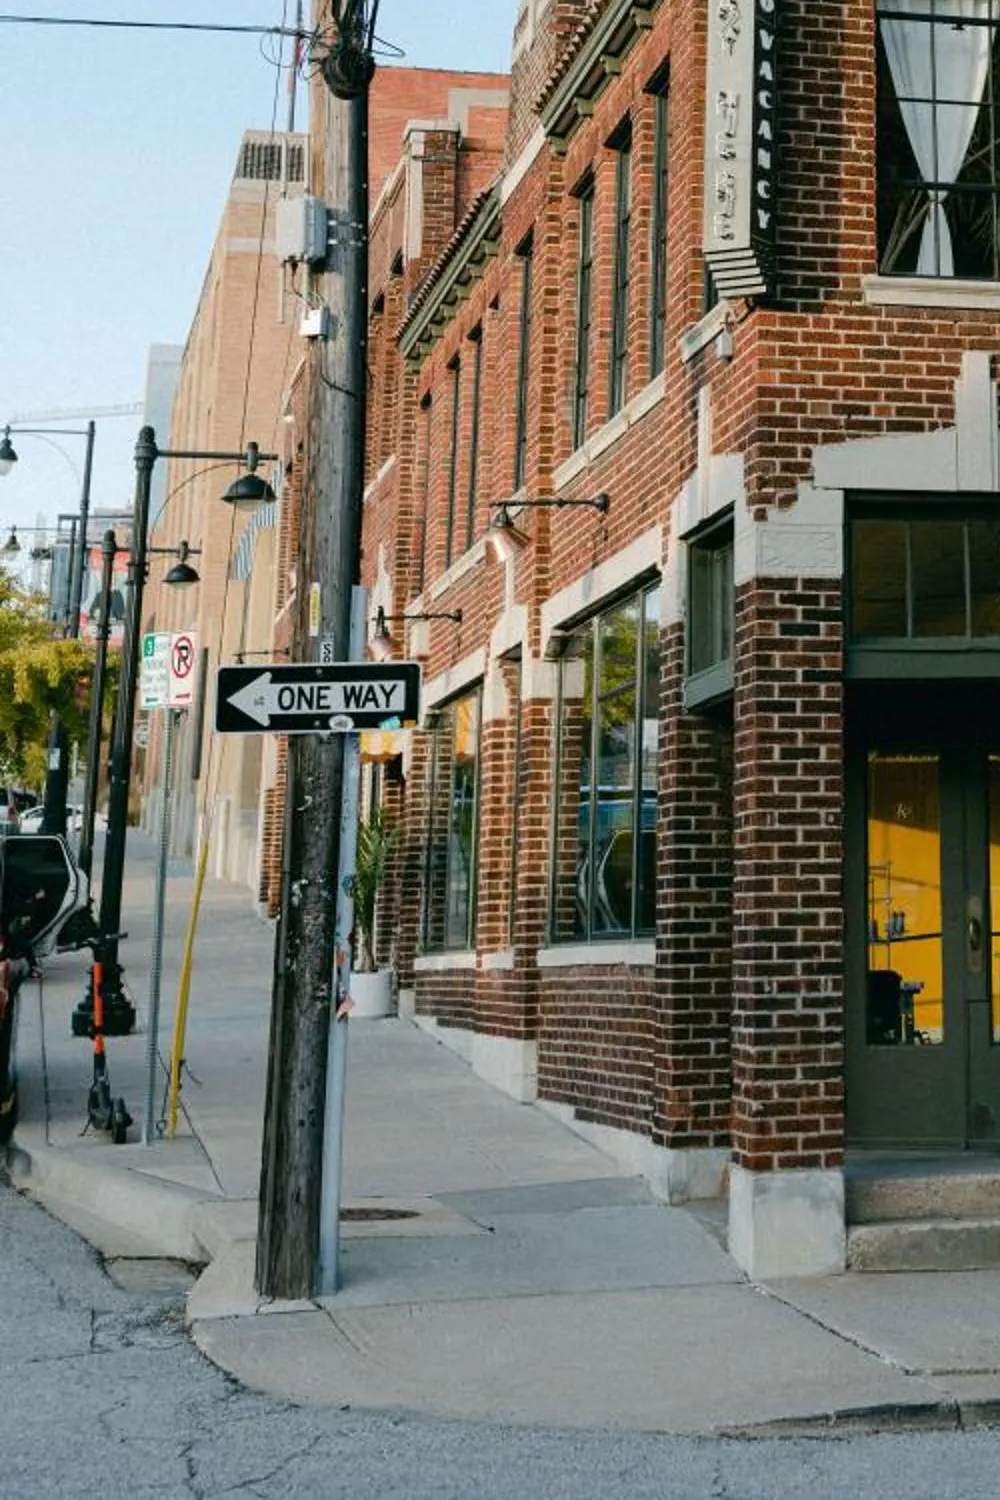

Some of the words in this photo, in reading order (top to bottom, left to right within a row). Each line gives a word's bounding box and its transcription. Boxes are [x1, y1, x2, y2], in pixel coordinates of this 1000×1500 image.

[757, 29, 775, 229] VACANCY
[277, 686, 331, 711] ONE
[343, 684, 397, 709] WAY
